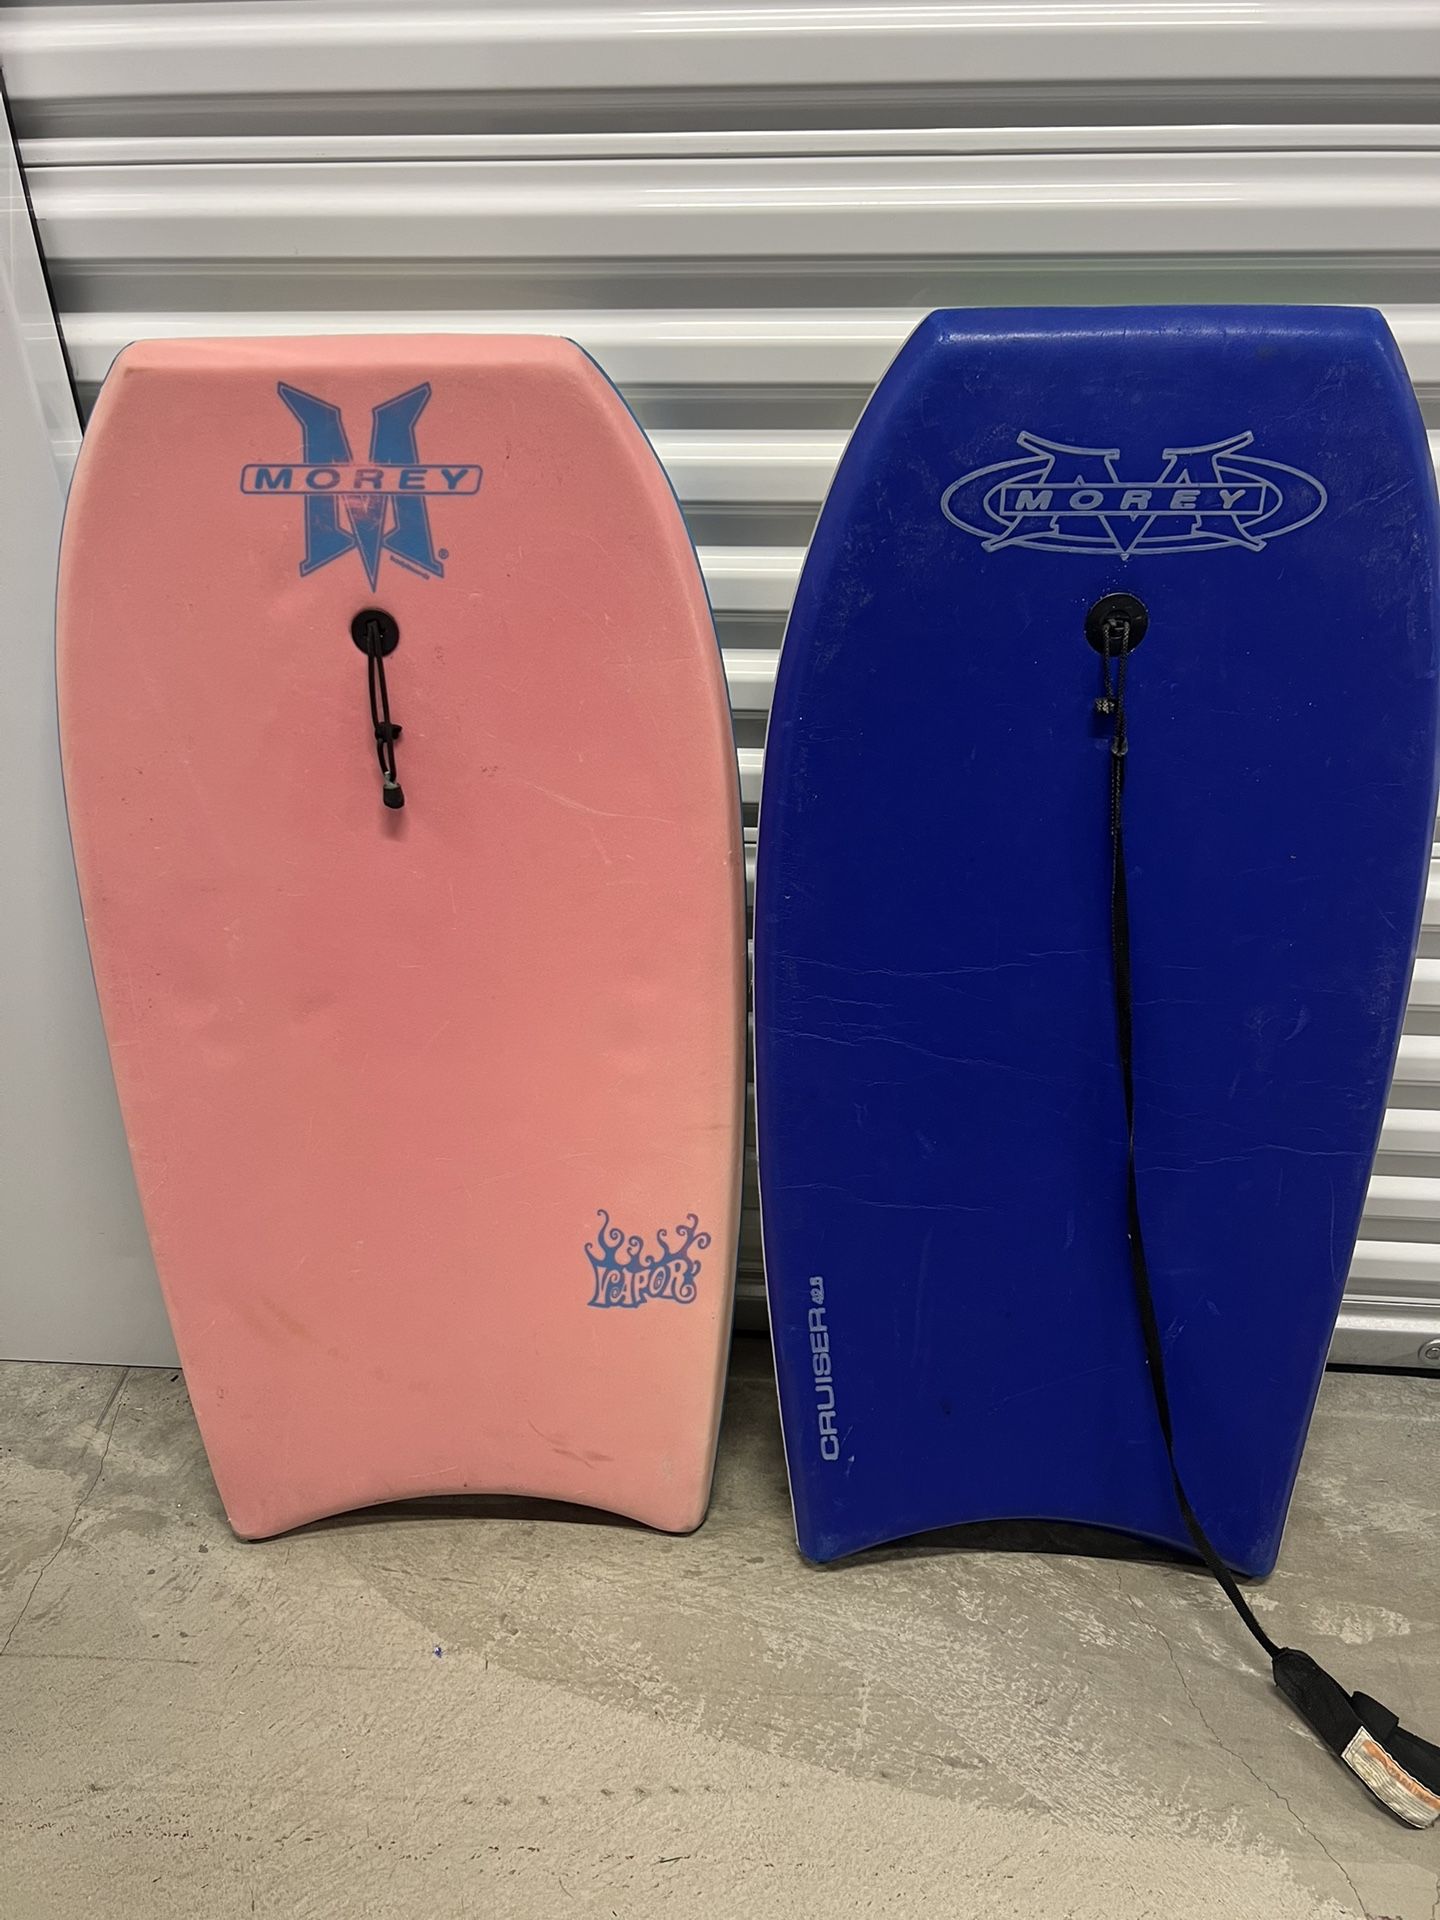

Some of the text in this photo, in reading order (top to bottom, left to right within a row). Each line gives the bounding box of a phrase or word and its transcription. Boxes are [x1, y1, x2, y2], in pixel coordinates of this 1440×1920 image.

[254, 467, 469, 490] MOREY
[1014, 489, 1246, 511] MOREY
[587, 1256, 701, 1308] VAPOR
[808, 1306, 840, 1461] CRUISER
